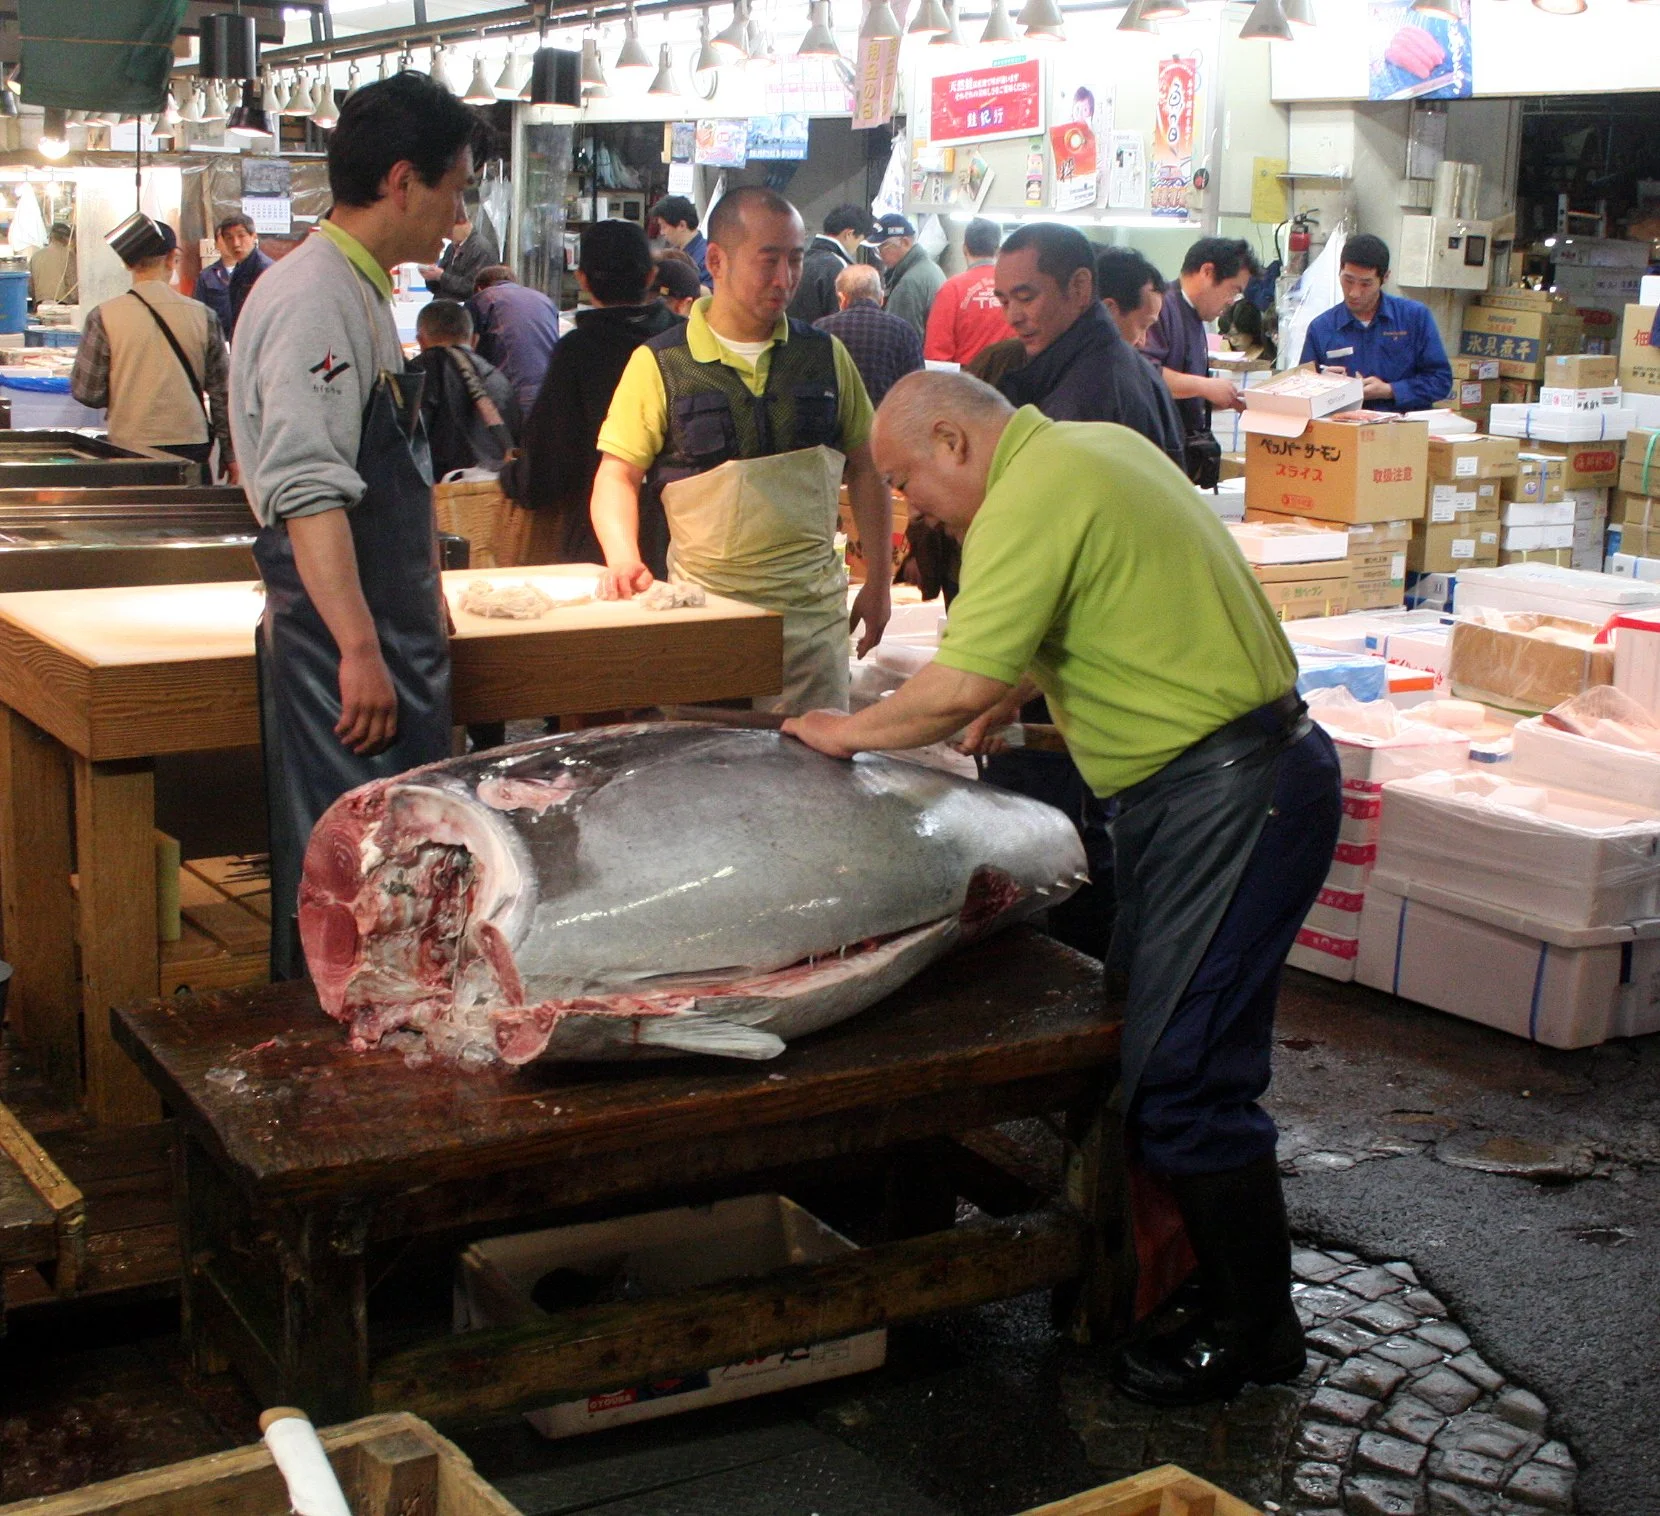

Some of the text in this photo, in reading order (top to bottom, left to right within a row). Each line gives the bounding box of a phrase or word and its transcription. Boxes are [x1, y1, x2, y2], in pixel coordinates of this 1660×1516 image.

[1275, 463, 1324, 483] スライス
[1372, 466, 1414, 484] 取扱注意
